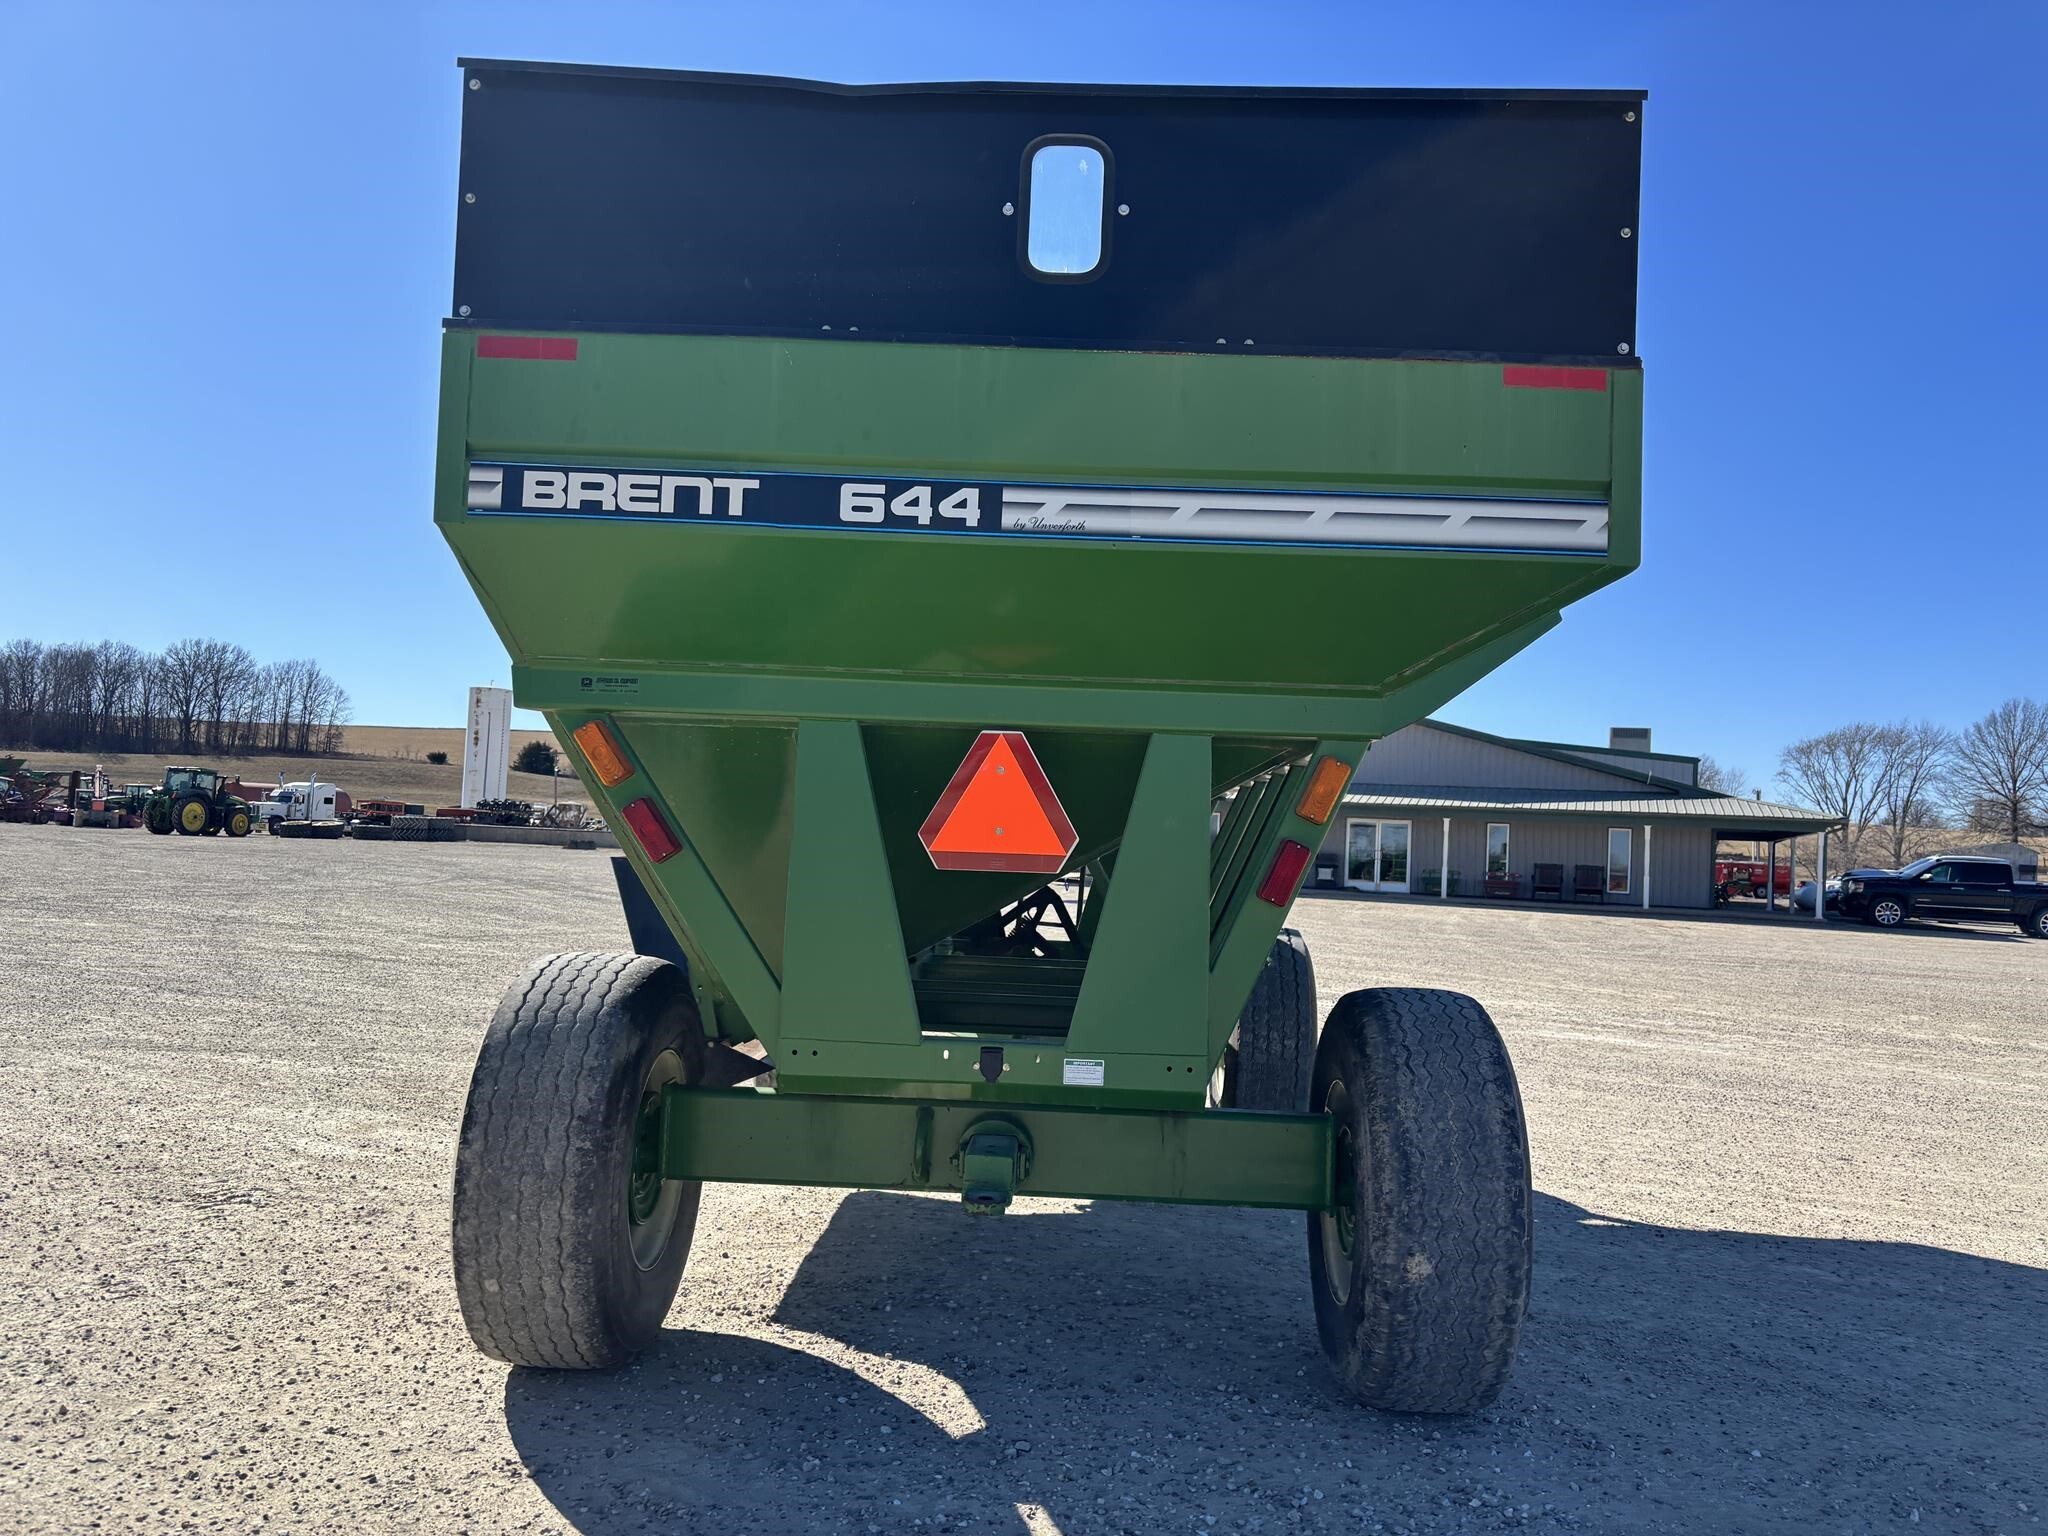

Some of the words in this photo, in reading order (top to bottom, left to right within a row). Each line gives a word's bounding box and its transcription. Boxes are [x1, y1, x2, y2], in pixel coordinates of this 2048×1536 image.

[522, 470, 760, 516] BRENT
[841, 483, 981, 527] 644
[1013, 518, 1026, 530] by
